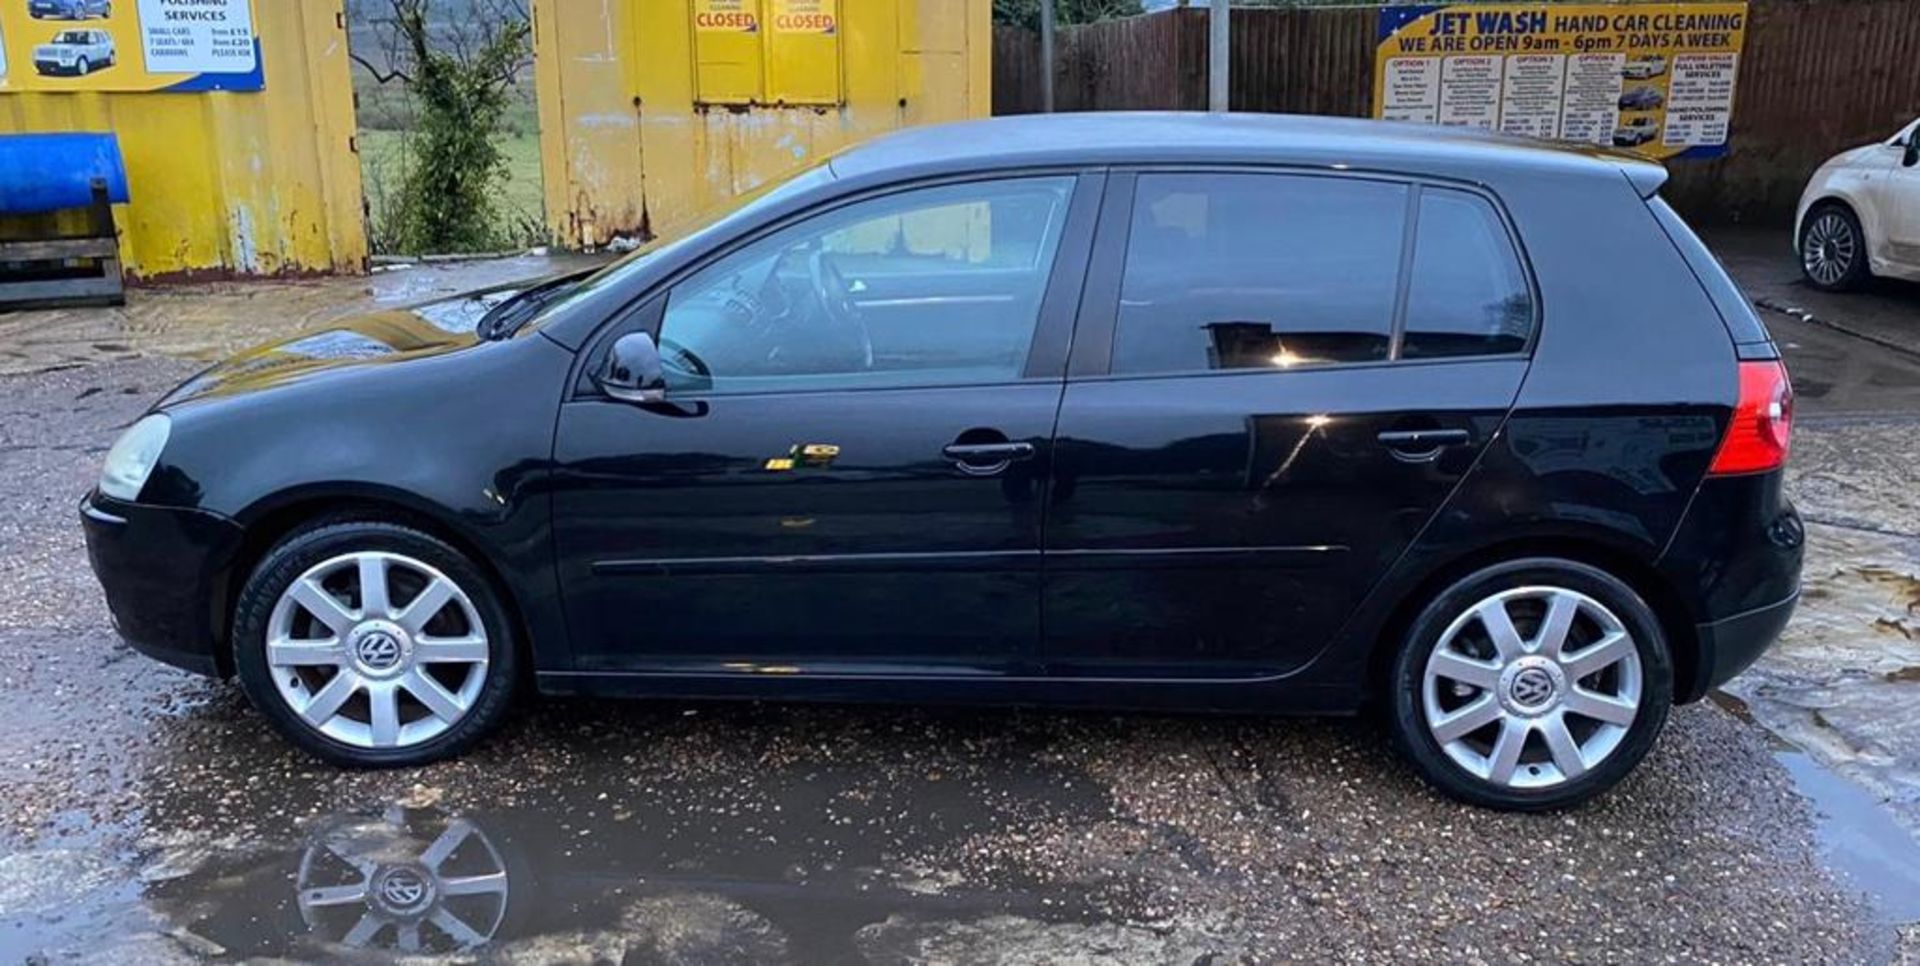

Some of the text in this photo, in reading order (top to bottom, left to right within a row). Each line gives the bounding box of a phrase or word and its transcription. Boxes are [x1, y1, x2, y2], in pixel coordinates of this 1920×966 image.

[165, 10, 226, 21] SERVICES
[697, 12, 755, 28] CLOSED
[776, 14, 833, 29] CLOSED
[1429, 10, 1743, 36] JET WASH HAND CAR CLEANING
[1399, 37, 1426, 52] WE
[1431, 37, 1465, 51] ARE
[1470, 36, 1519, 51] OPEN
[1522, 35, 1559, 50] 9am
[1573, 35, 1611, 51] 6pm
[1615, 35, 1625, 49] 7
[1629, 34, 1670, 48] DAYS
[1673, 34, 1685, 48] A
[1687, 33, 1730, 47] WEEK
